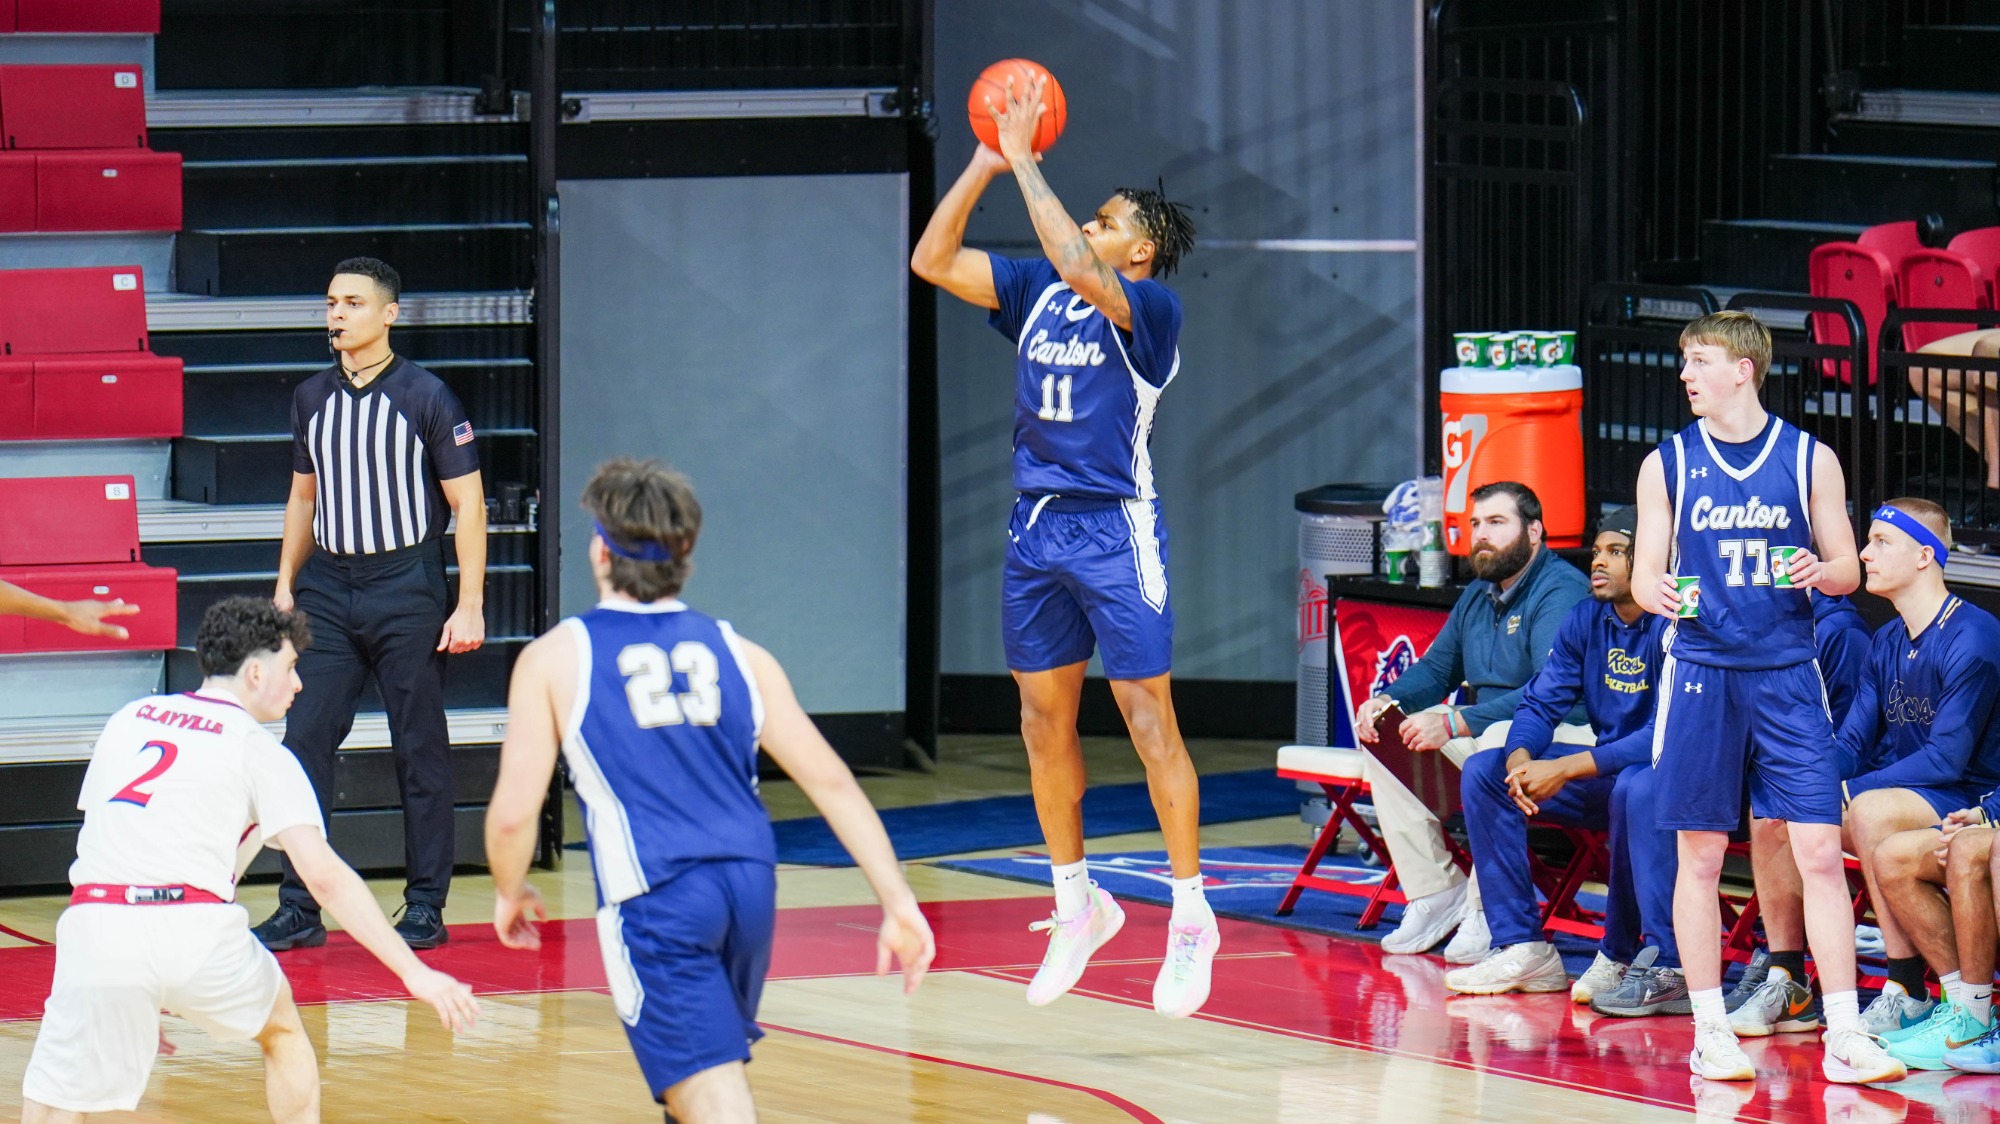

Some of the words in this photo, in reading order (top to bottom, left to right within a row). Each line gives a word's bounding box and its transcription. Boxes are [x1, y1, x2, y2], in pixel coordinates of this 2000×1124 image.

[1027, 328, 1107, 367] Canton
[1490, 344, 1506, 366] G
[1038, 373, 1074, 423] 11
[1442, 420, 1463, 469] G
[1690, 495, 1792, 532] Canton
[1717, 538, 1771, 587] 77
[1683, 584, 1700, 608] G
[616, 641, 721, 729] 23
[136, 704, 223, 735] CLAYVILLE
[107, 740, 178, 808] 2
